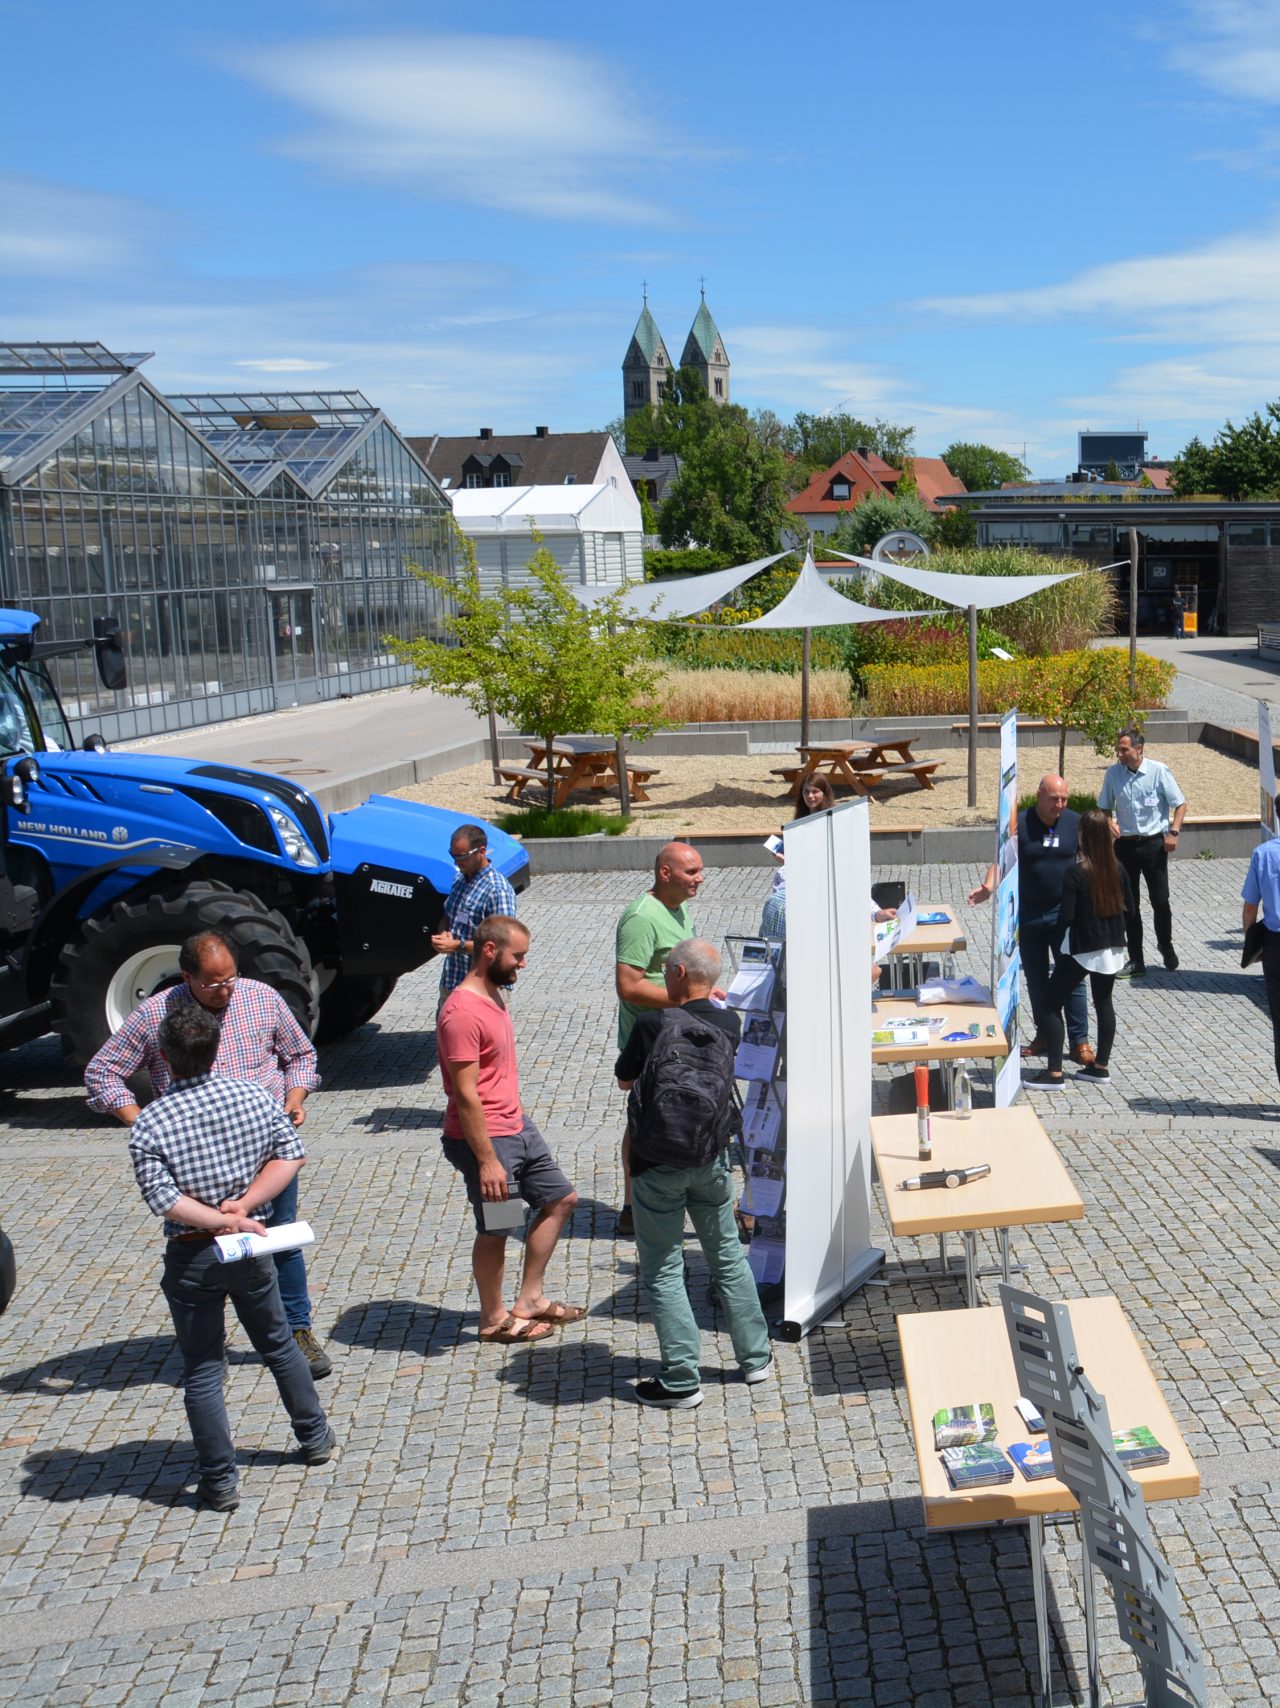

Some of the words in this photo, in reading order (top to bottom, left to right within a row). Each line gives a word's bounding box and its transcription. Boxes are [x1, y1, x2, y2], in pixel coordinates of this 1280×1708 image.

[17, 821, 46, 832] NEW
[48, 824, 108, 841] HOLLAND
[370, 879, 414, 899] AGRATEC
